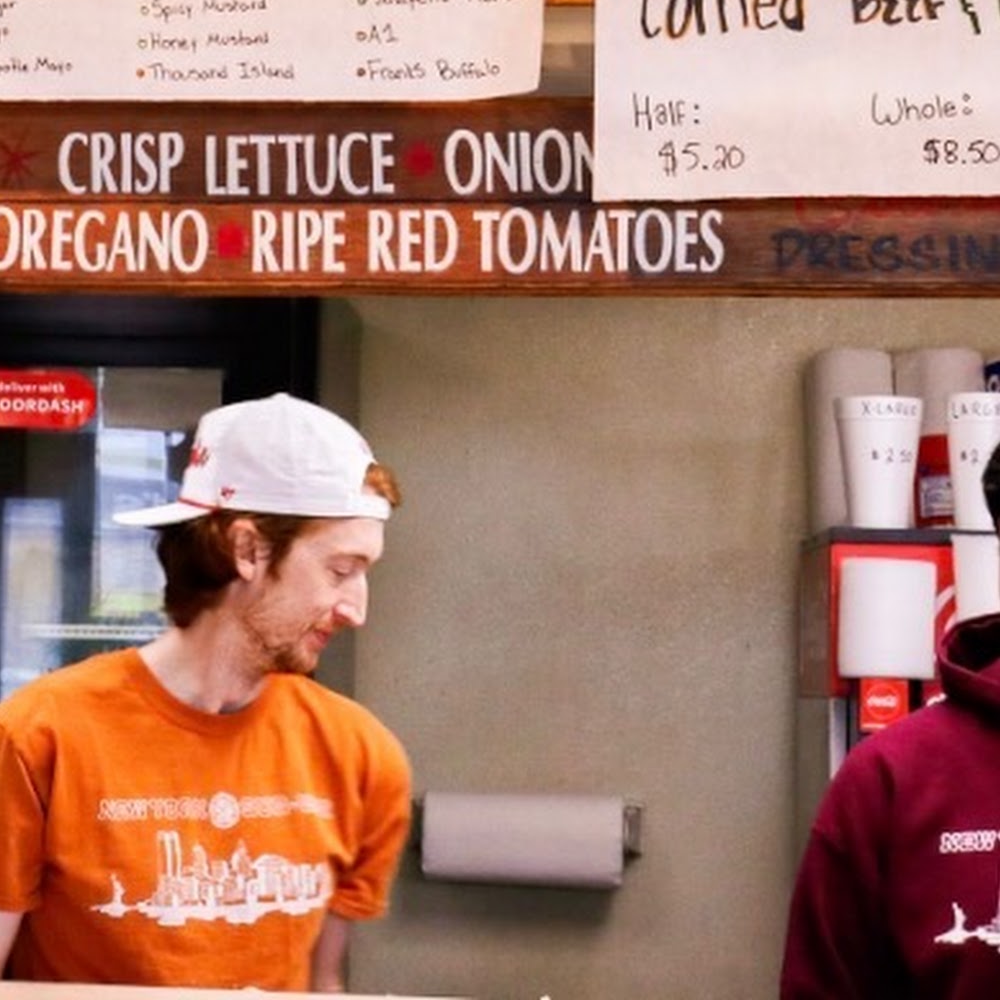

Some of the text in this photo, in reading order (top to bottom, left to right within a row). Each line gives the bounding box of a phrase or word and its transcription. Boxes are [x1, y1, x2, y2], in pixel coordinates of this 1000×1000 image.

[150, 30, 197, 53] Honey
[367, 24, 398, 44] A1
[149, 62, 295, 83] Thousand Island
[436, 59, 501, 81] Buffalo
[632, 92, 974, 131] Half: Whole:
[58, 131, 185, 194] CRISP
[205, 132, 395, 196] LETTUCE
[657, 138, 999, 178] $5.20 $8.50
[251, 209, 346, 274] RIPE
[368, 207, 458, 272] RED
[474, 207, 725, 274] TOMATOES
[38, 382, 66, 393] with
